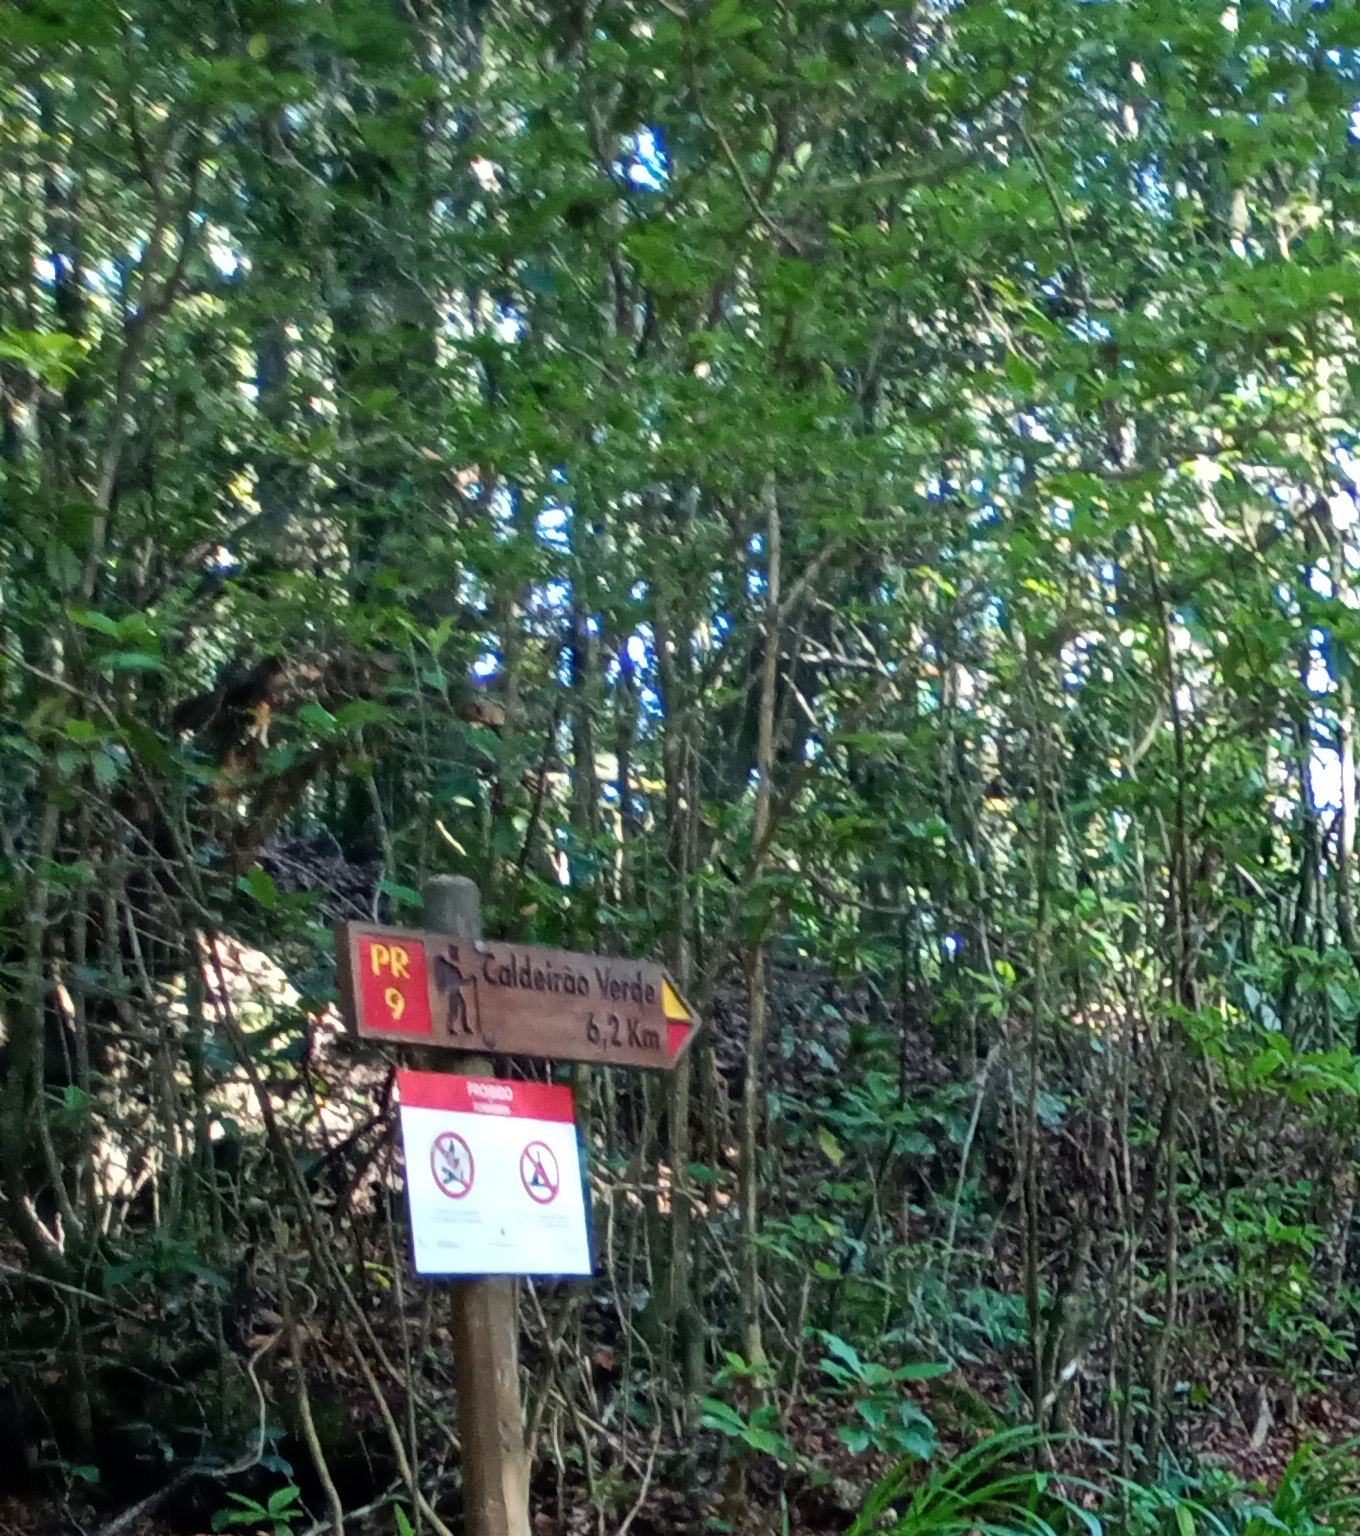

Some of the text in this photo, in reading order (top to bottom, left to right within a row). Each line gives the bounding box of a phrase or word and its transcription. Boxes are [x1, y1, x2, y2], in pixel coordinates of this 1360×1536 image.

[370, 943, 410, 979] PR
[482, 952, 656, 1004] Caldeirão Verde
[384, 987, 406, 1021] 9
[586, 1011, 661, 1052] 6,2 Km
